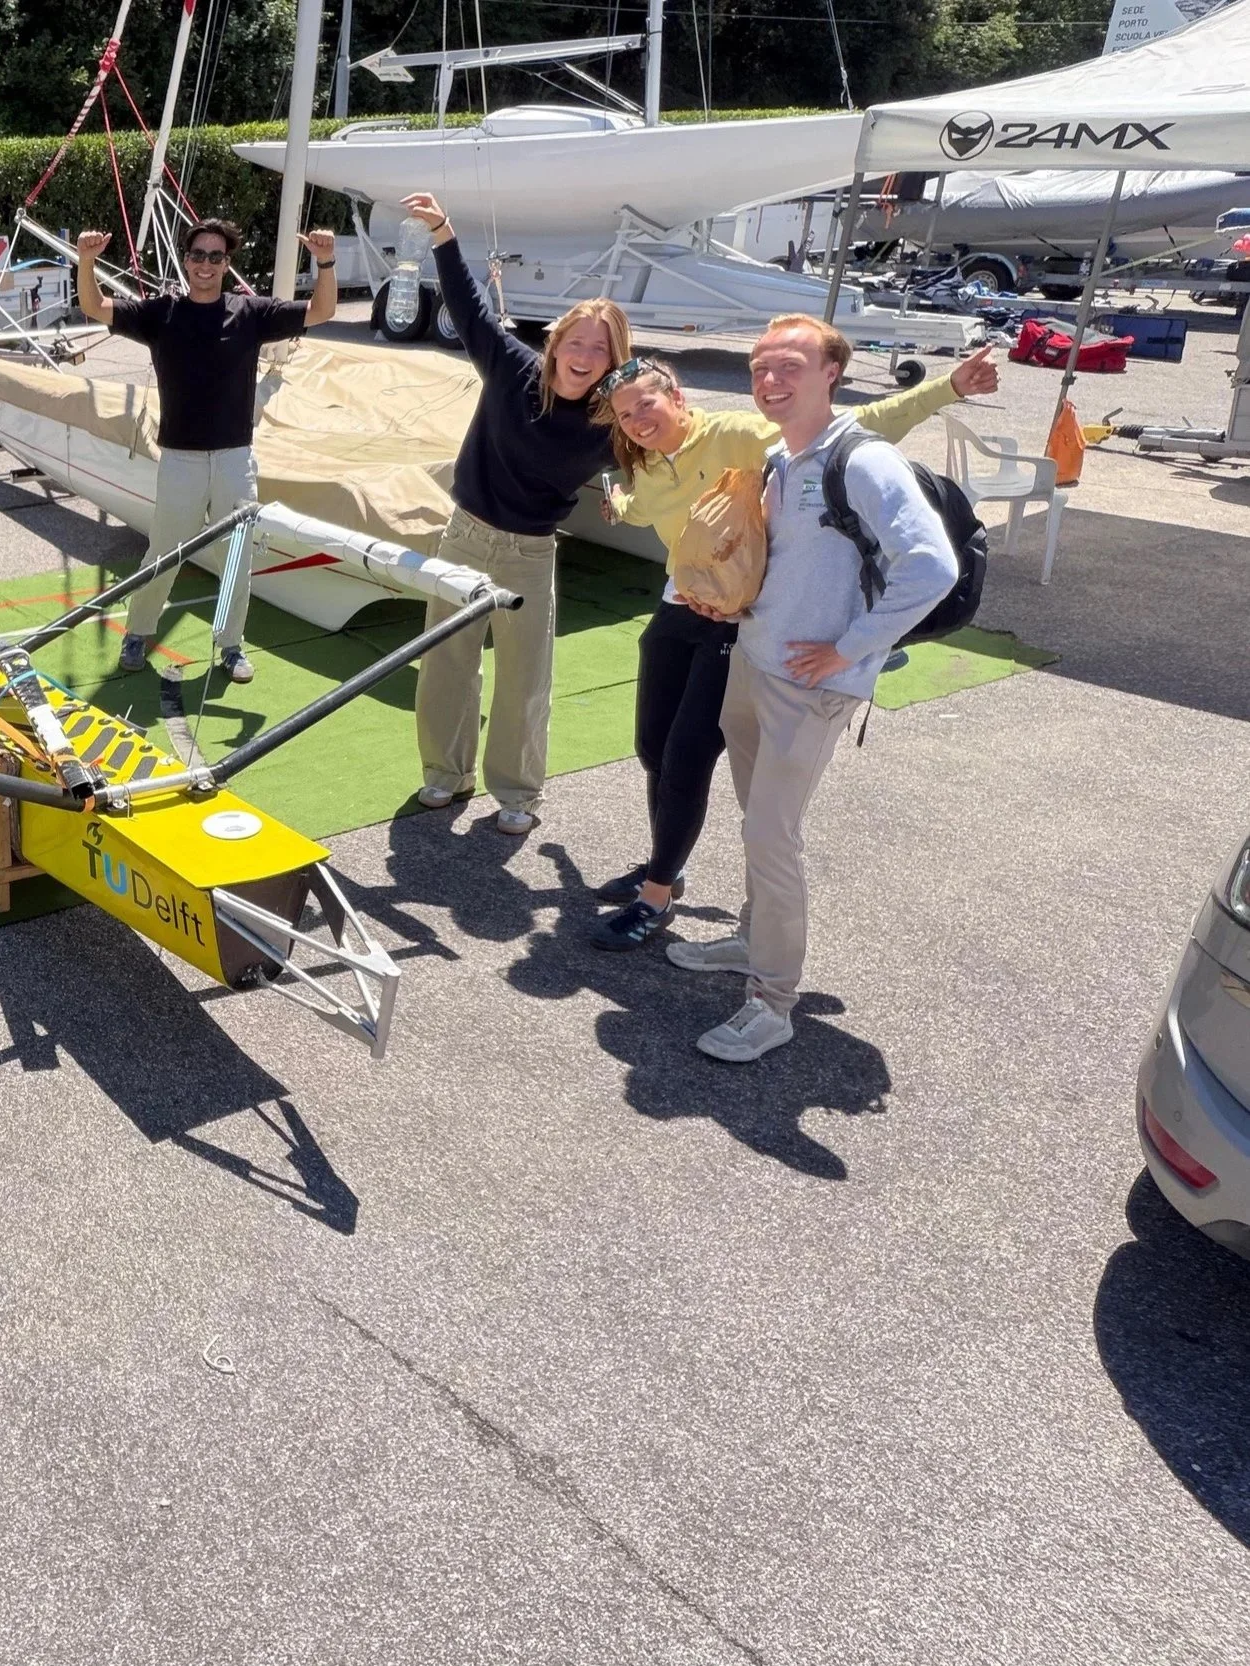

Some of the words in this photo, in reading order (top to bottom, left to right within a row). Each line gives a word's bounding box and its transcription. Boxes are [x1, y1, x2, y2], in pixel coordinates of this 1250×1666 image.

[1122, 6, 1146, 15] SEDE
[1118, 19, 1149, 28] PORTO
[1115, 31, 1151, 41] SCUOLA
[995, 122, 1177, 150] 24MX
[130, 868, 206, 947] Delft
